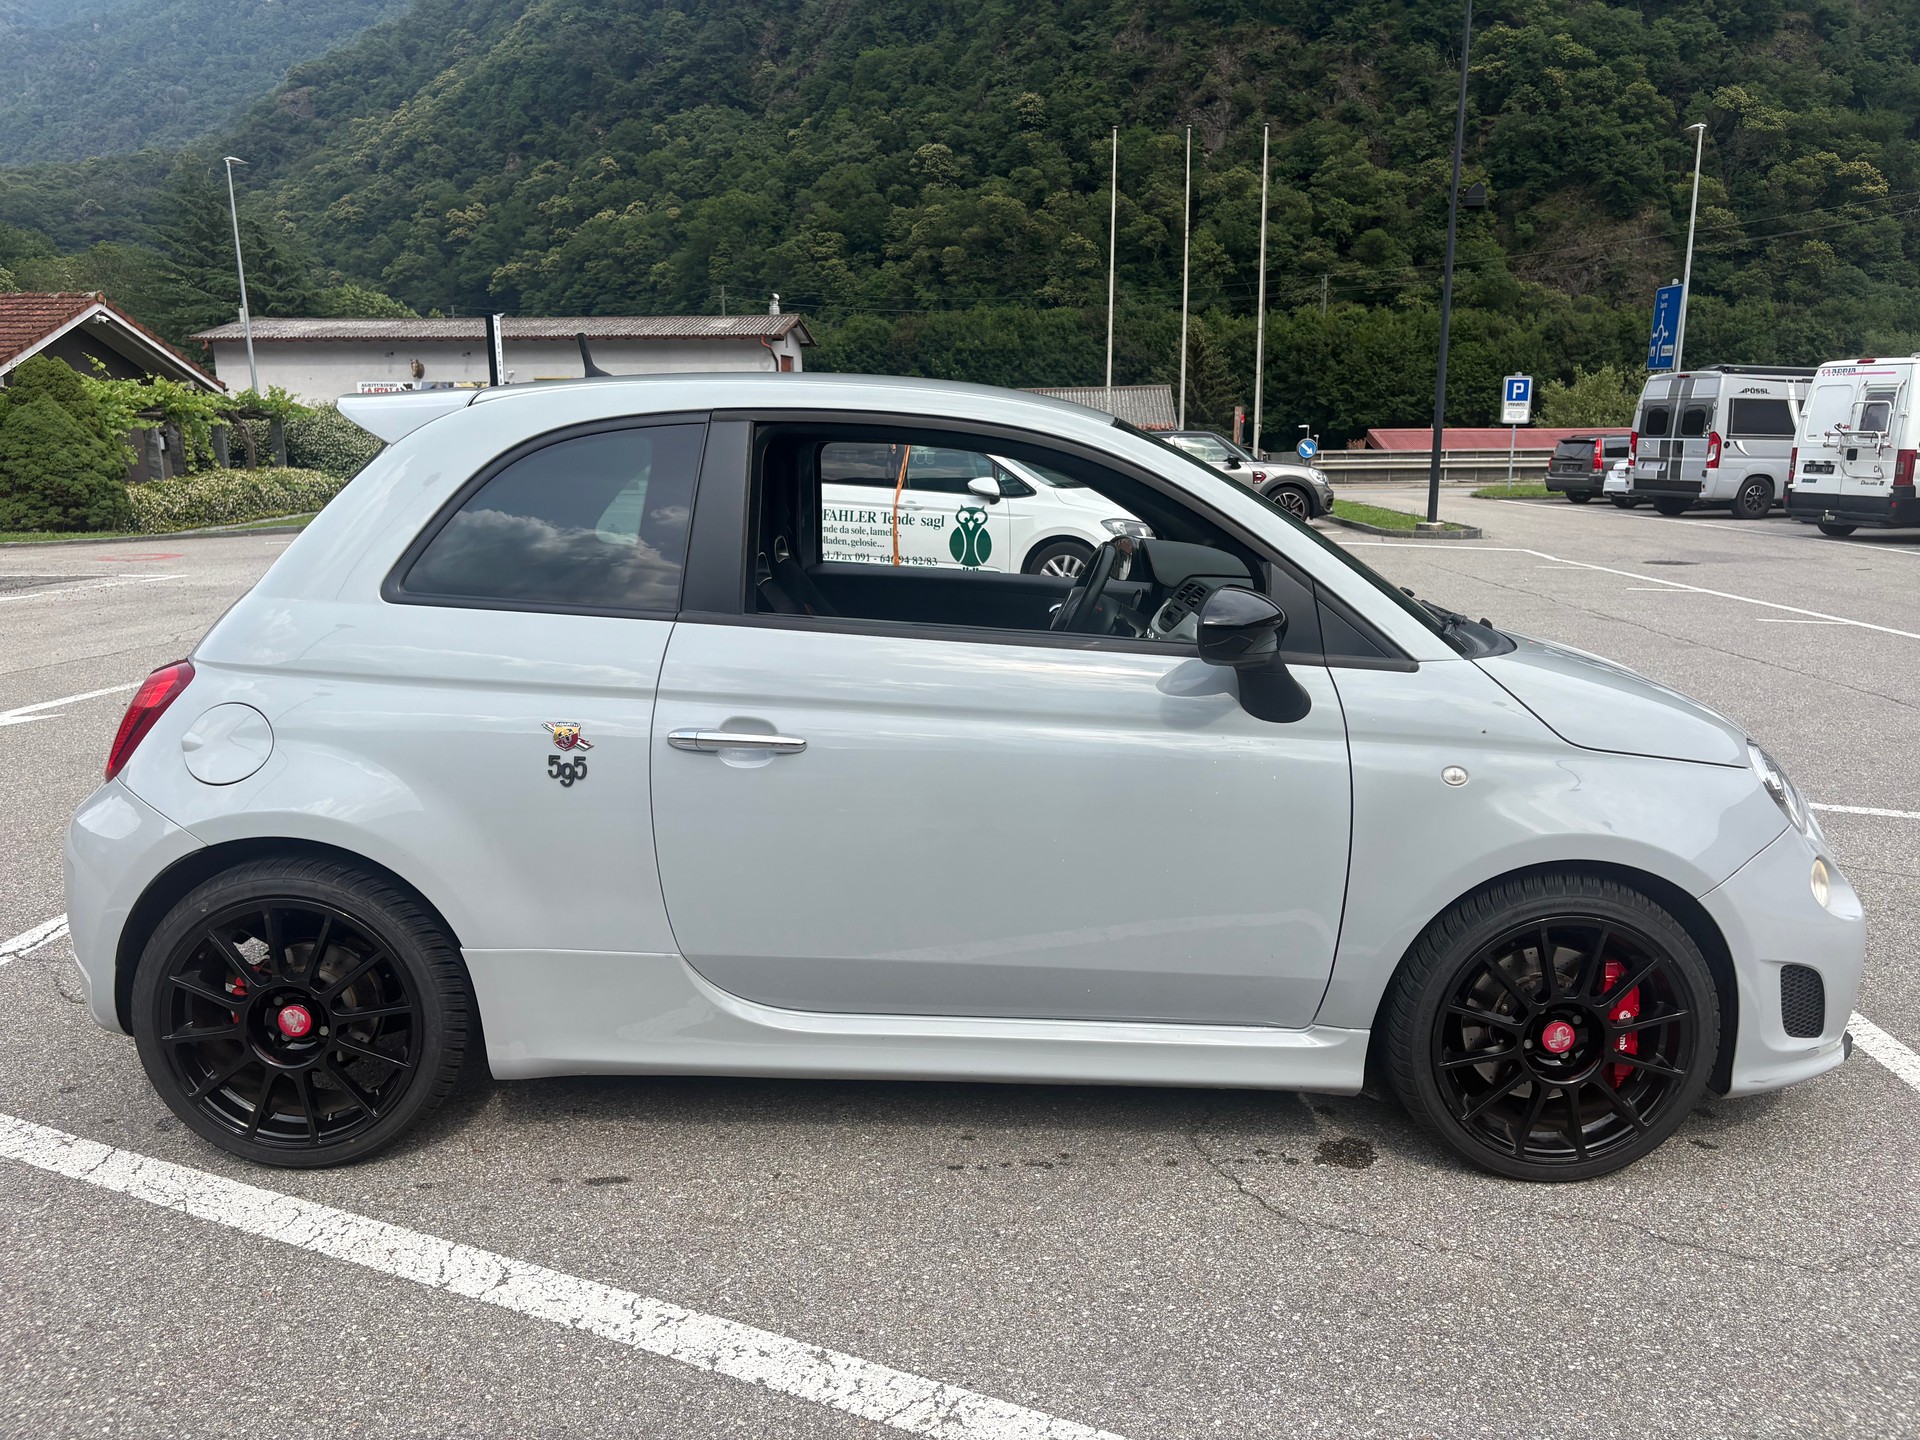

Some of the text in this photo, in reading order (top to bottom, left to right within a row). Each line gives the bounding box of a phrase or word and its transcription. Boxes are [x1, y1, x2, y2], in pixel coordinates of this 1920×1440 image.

[1512, 382, 1525, 399] P
[822, 509, 877, 523] FAHLER
[920, 515, 945, 530] sagl
[822, 525, 902, 538] nde da sole, lamel,
[822, 536, 850, 546] lladen,
[822, 551, 852, 561] el./Fax
[855, 552, 870, 562] 091
[912, 556, 938, 566] 82/83
[548, 754, 588, 788] 595
